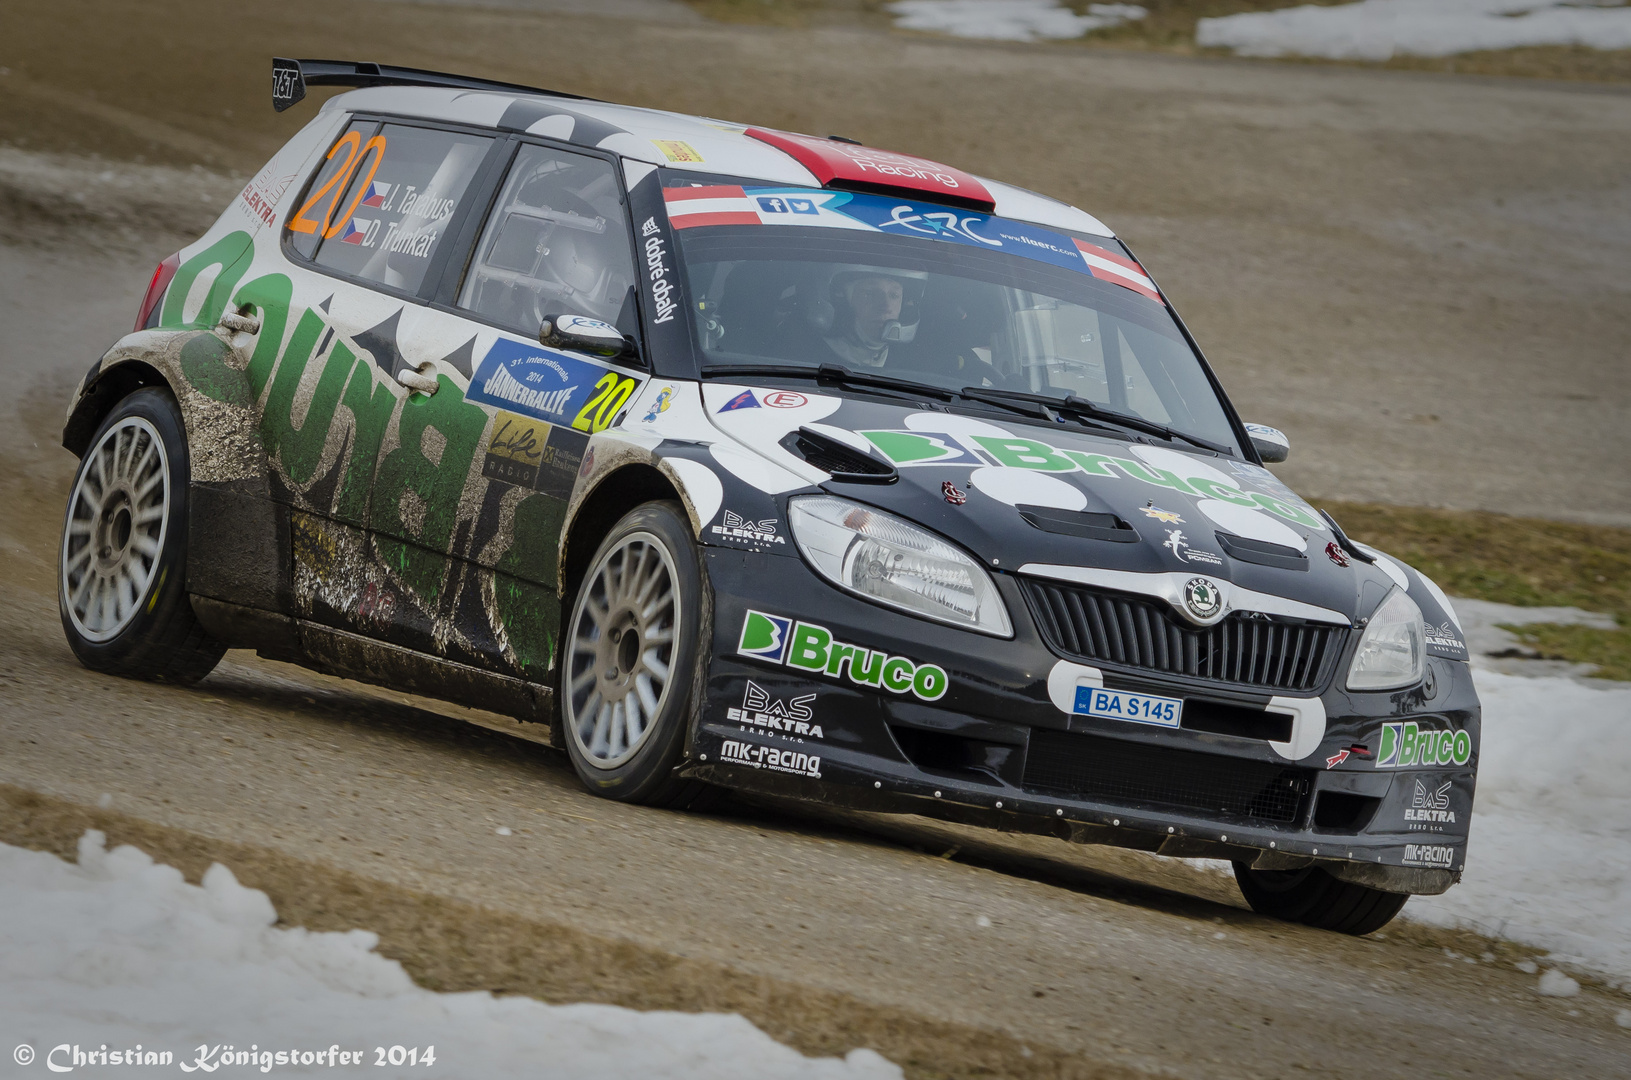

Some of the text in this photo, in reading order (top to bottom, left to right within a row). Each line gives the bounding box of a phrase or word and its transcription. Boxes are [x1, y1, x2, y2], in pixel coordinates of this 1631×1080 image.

[272, 68, 299, 99] T&T
[285, 130, 387, 239] 20
[852, 158, 959, 188] Racing
[242, 184, 277, 228] ELEKTRA
[381, 184, 455, 221] J. Tarabus
[362, 219, 438, 258] D. Trunkát
[999, 233, 1078, 258] www.fiaerc.com
[645, 237, 677, 324] dobré obaly
[510, 358, 524, 367] 31.
[525, 371, 544, 384] 2014
[571, 372, 635, 434] 20
[490, 420, 542, 459] Life
[969, 434, 1328, 531] Bruco
[712, 525, 786, 545] ELEKTRA
[723, 509, 778, 534] BAS
[1425, 636, 1466, 650] ELEKTRA
[786, 620, 949, 701] Bruco
[742, 679, 817, 722] BAS
[1077, 702, 1087, 710] SK
[1095, 693, 1175, 721] BA S145
[727, 707, 824, 739] ELEKTRA
[740, 725, 804, 744] BRNO s.r.o.
[1397, 721, 1472, 767] Bruco
[768, 764, 807, 776] MOTORSPORT
[1412, 779, 1452, 810] BAS
[1404, 808, 1456, 824] ELEKTRA
